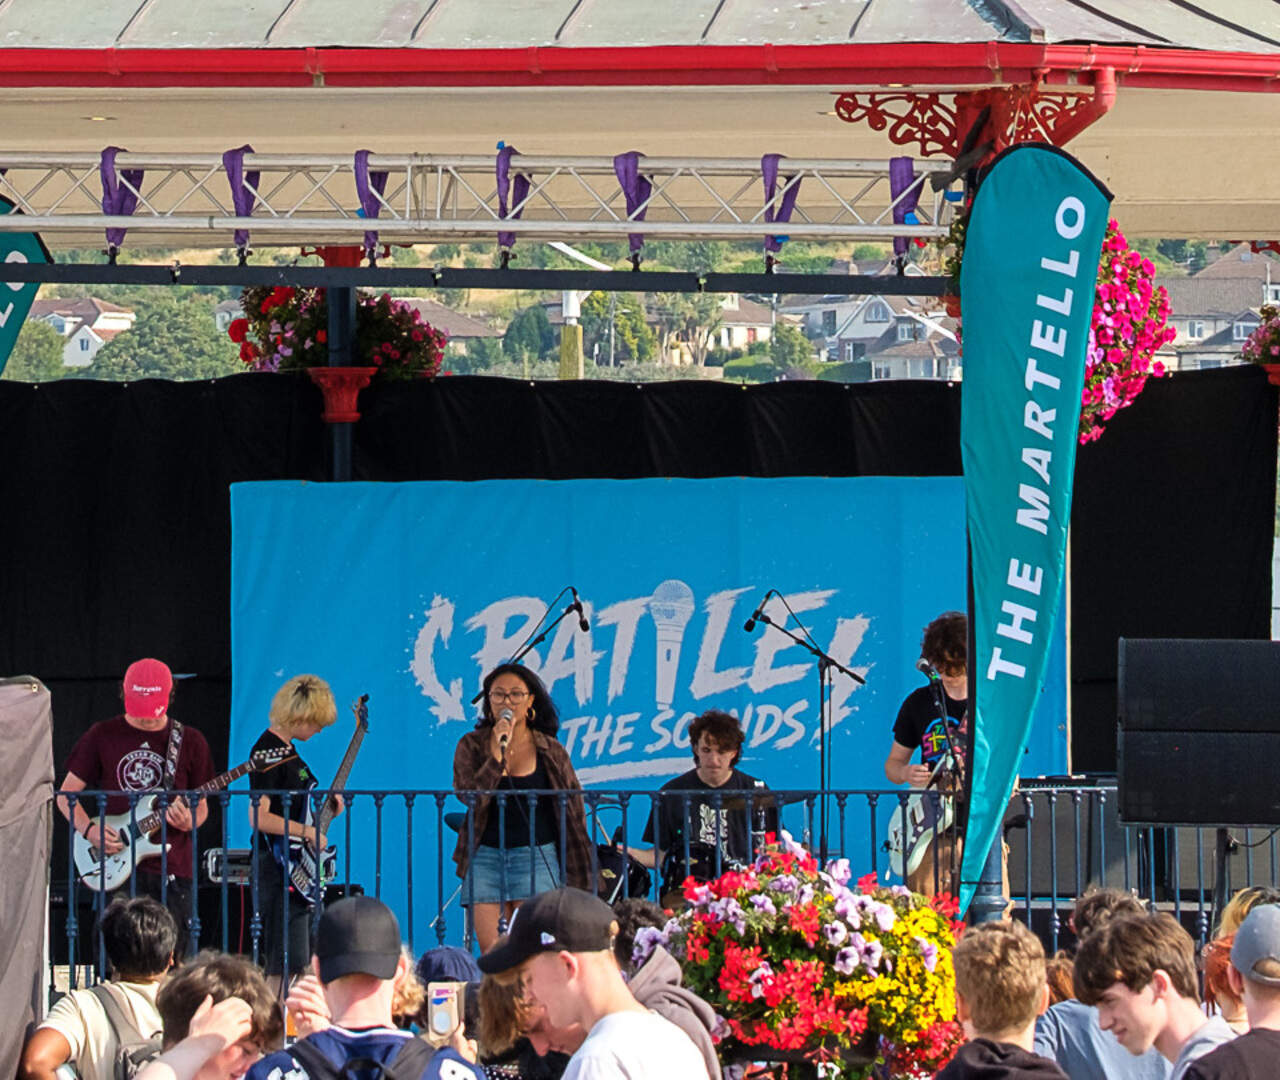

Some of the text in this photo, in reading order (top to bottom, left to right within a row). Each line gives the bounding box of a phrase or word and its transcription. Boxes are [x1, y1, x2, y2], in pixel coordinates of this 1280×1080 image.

[987, 196, 1086, 681] THE MARTELLO
[561, 699, 809, 760] THE SONDS
